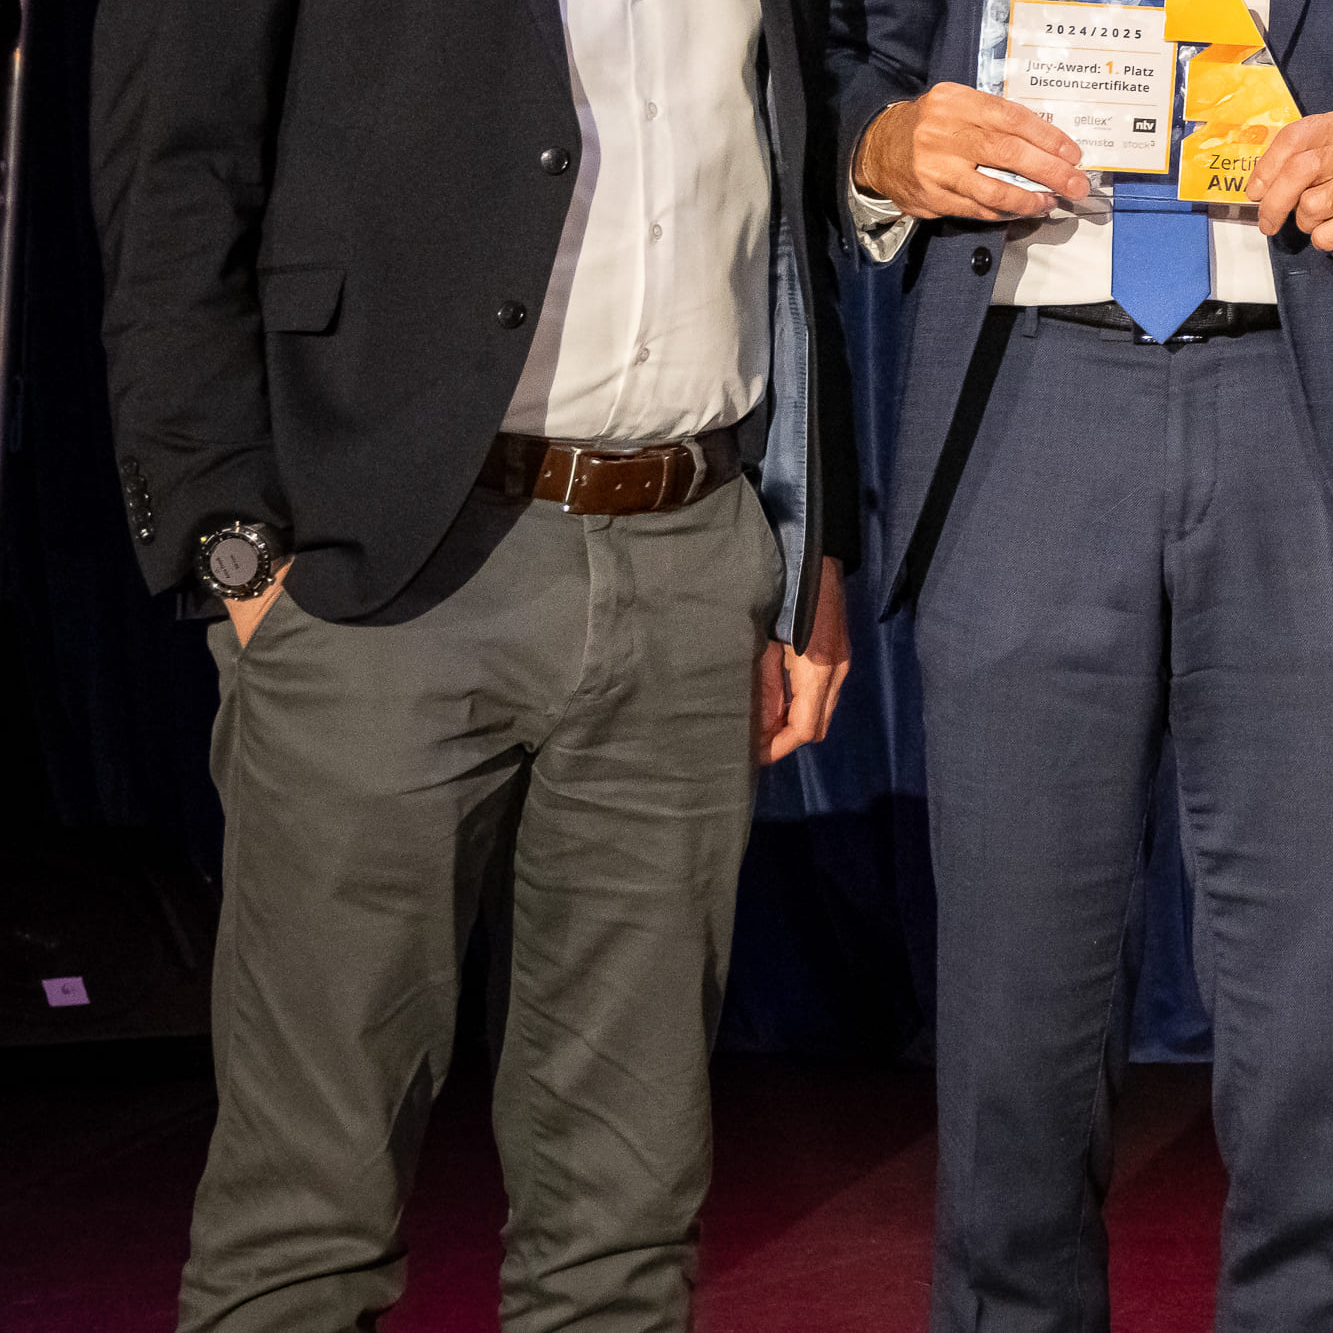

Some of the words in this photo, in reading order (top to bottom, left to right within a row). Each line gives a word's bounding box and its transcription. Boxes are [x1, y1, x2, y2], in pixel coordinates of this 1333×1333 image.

[1045, 24, 1142, 39] 2024/2025
[1026, 60, 1101, 74] Jury-Award:
[1123, 65, 1154, 77] Platz
[1030, 76, 1150, 93] Discountzertifikate
[1209, 154, 1263, 172] Zertif
